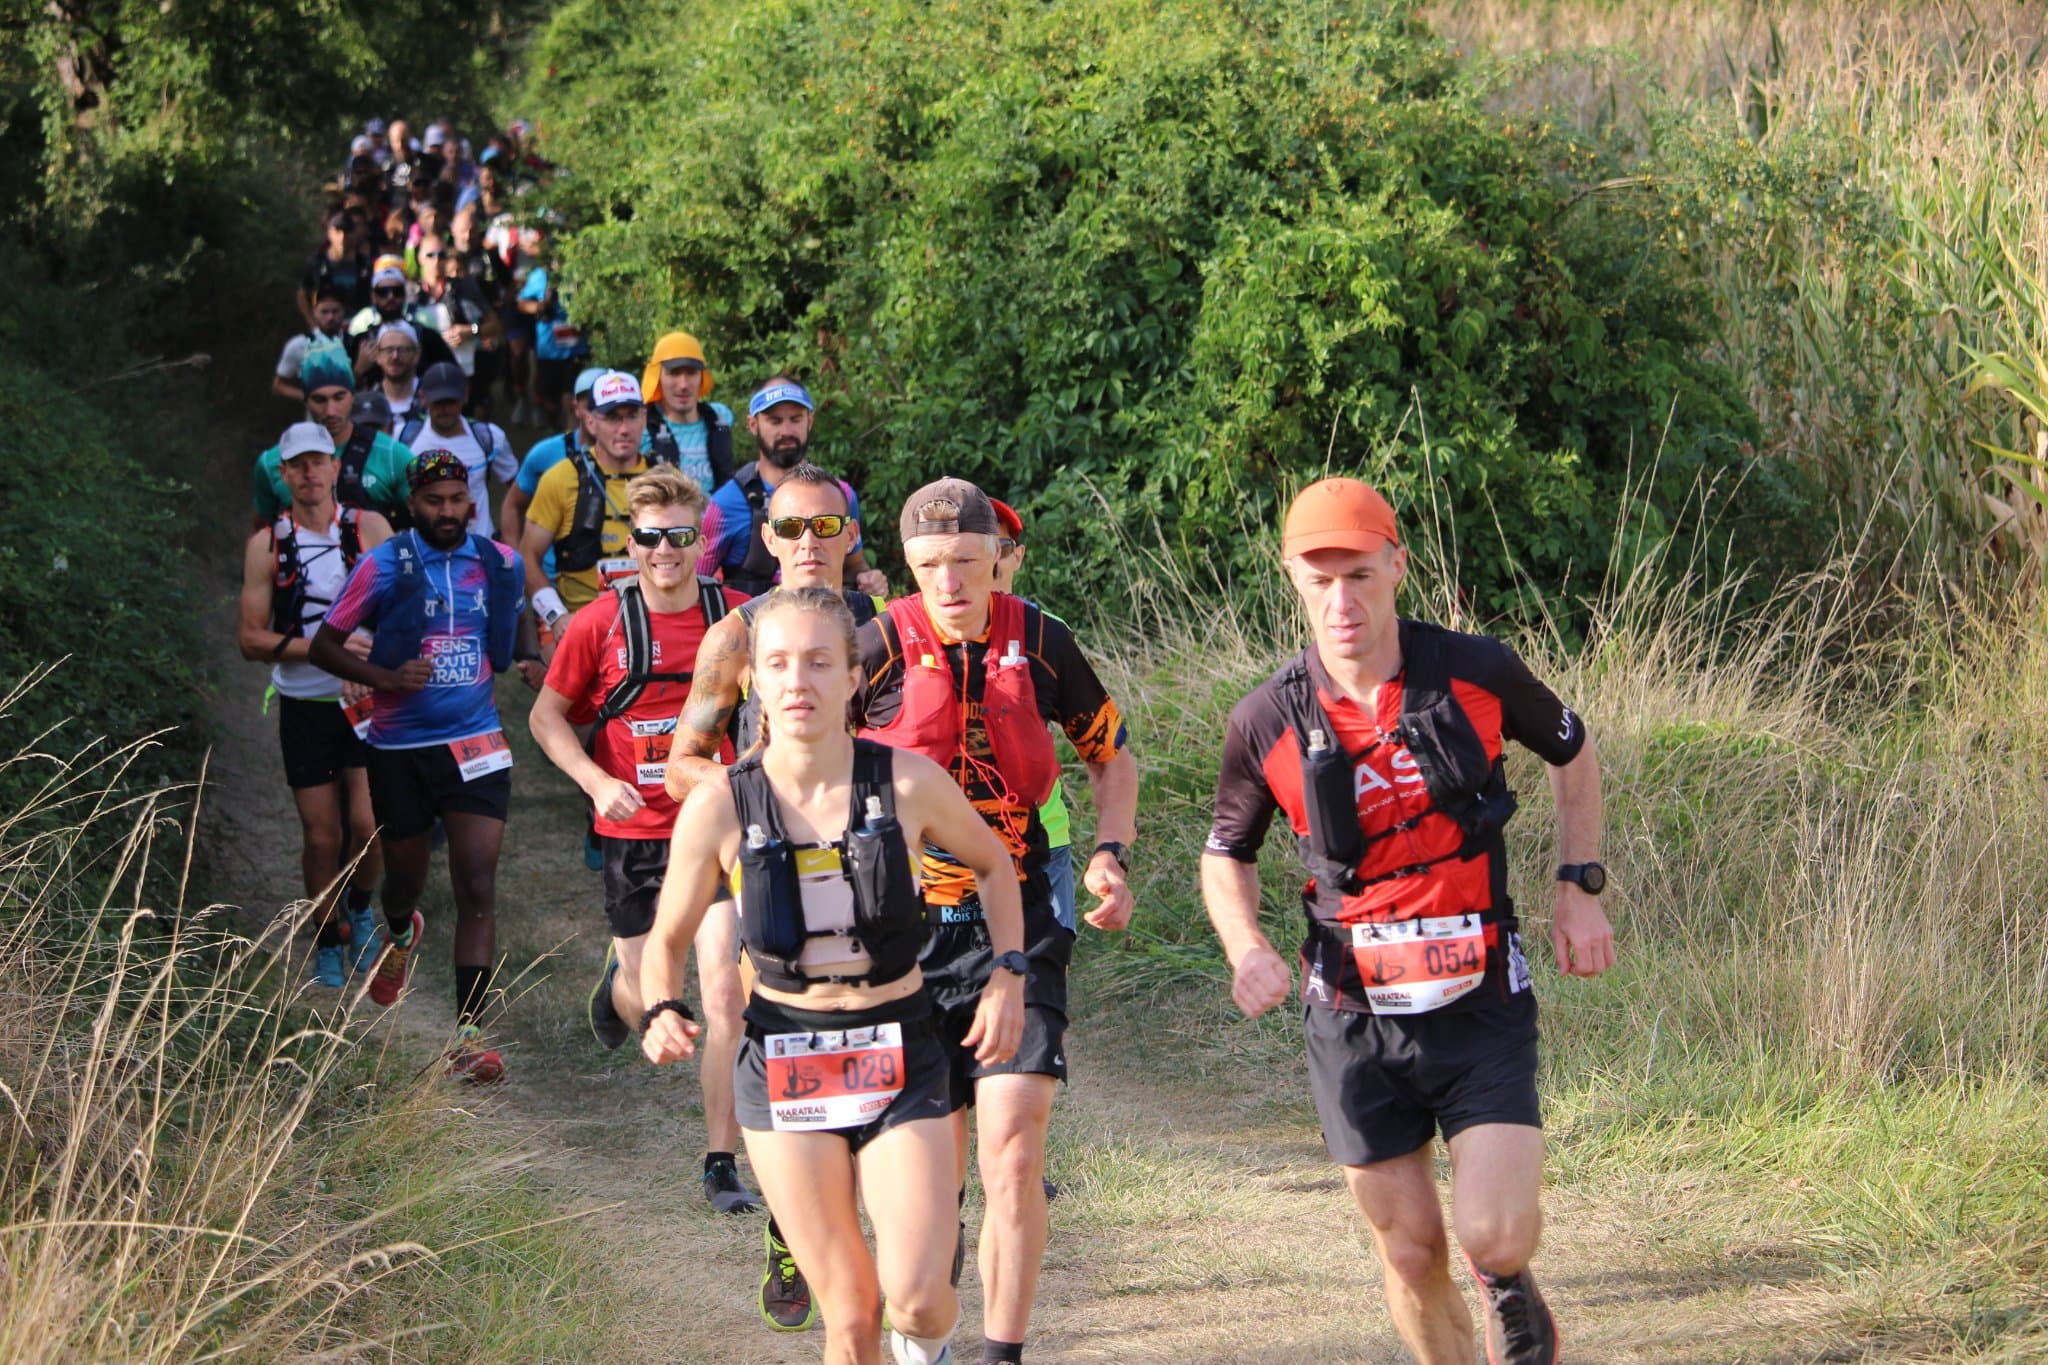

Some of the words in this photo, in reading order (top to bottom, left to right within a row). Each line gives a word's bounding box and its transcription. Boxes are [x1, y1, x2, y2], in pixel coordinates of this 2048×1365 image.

[431, 640, 471, 654] SENS
[431, 652, 477, 669] OUTE
[1424, 941, 1479, 977] 054
[842, 1053, 897, 1091] 029
[776, 1104, 828, 1118] MARATRAIL
